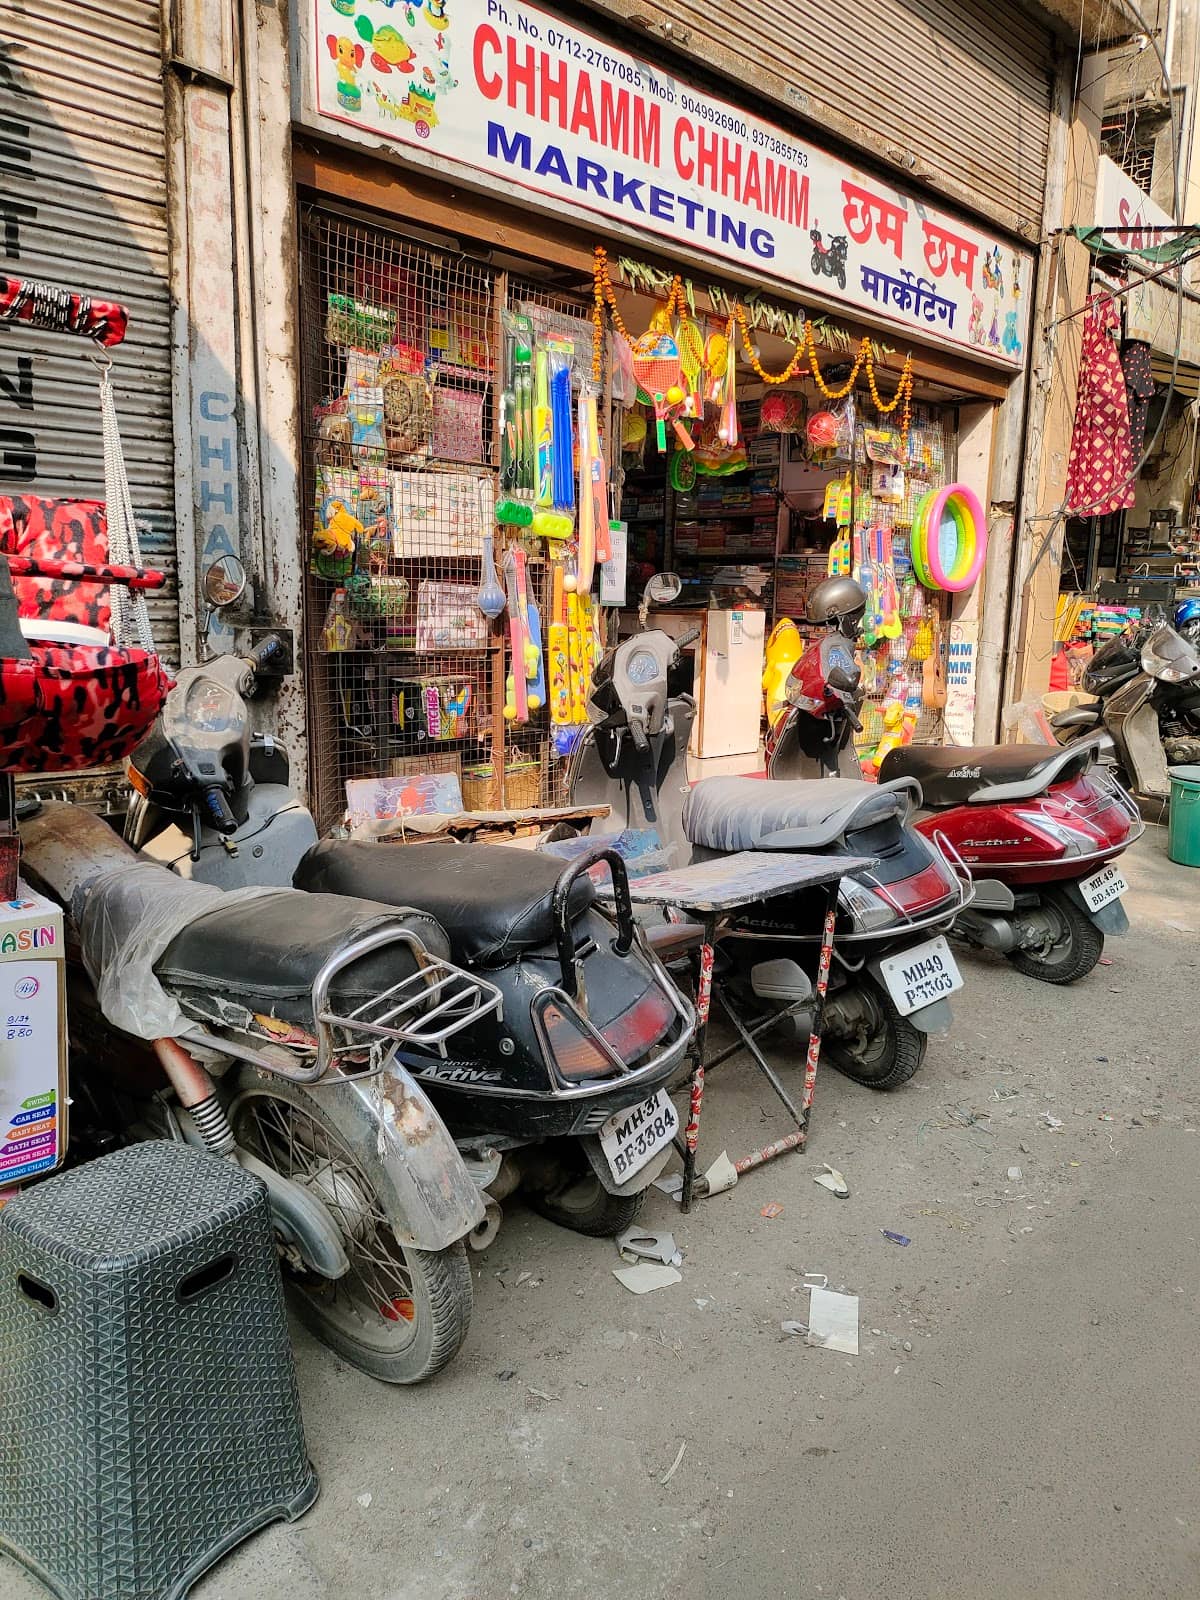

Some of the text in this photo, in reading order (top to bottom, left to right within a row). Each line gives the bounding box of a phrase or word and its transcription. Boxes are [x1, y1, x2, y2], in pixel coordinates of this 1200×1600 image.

[487, 0, 808, 168] Ph. No. 0712-2767085, Mob: 9049926900, 9373855753
[473, 23, 810, 231] CHHAMM CHHAMM
[488, 120, 775, 259] MARKETING
[841, 178, 979, 290] छम छम
[860, 264, 957, 329] मार्केटिंग
[736, 916, 796, 929] Activa
[420, 1065, 503, 1081] Activa
[16, 1108, 51, 1124] CAR SEAT
[12, 1121, 52, 1138] BABY SEAT
[8, 1135, 51, 1152] BATH SEAT
[32, 1147, 51, 1158] SEAT
